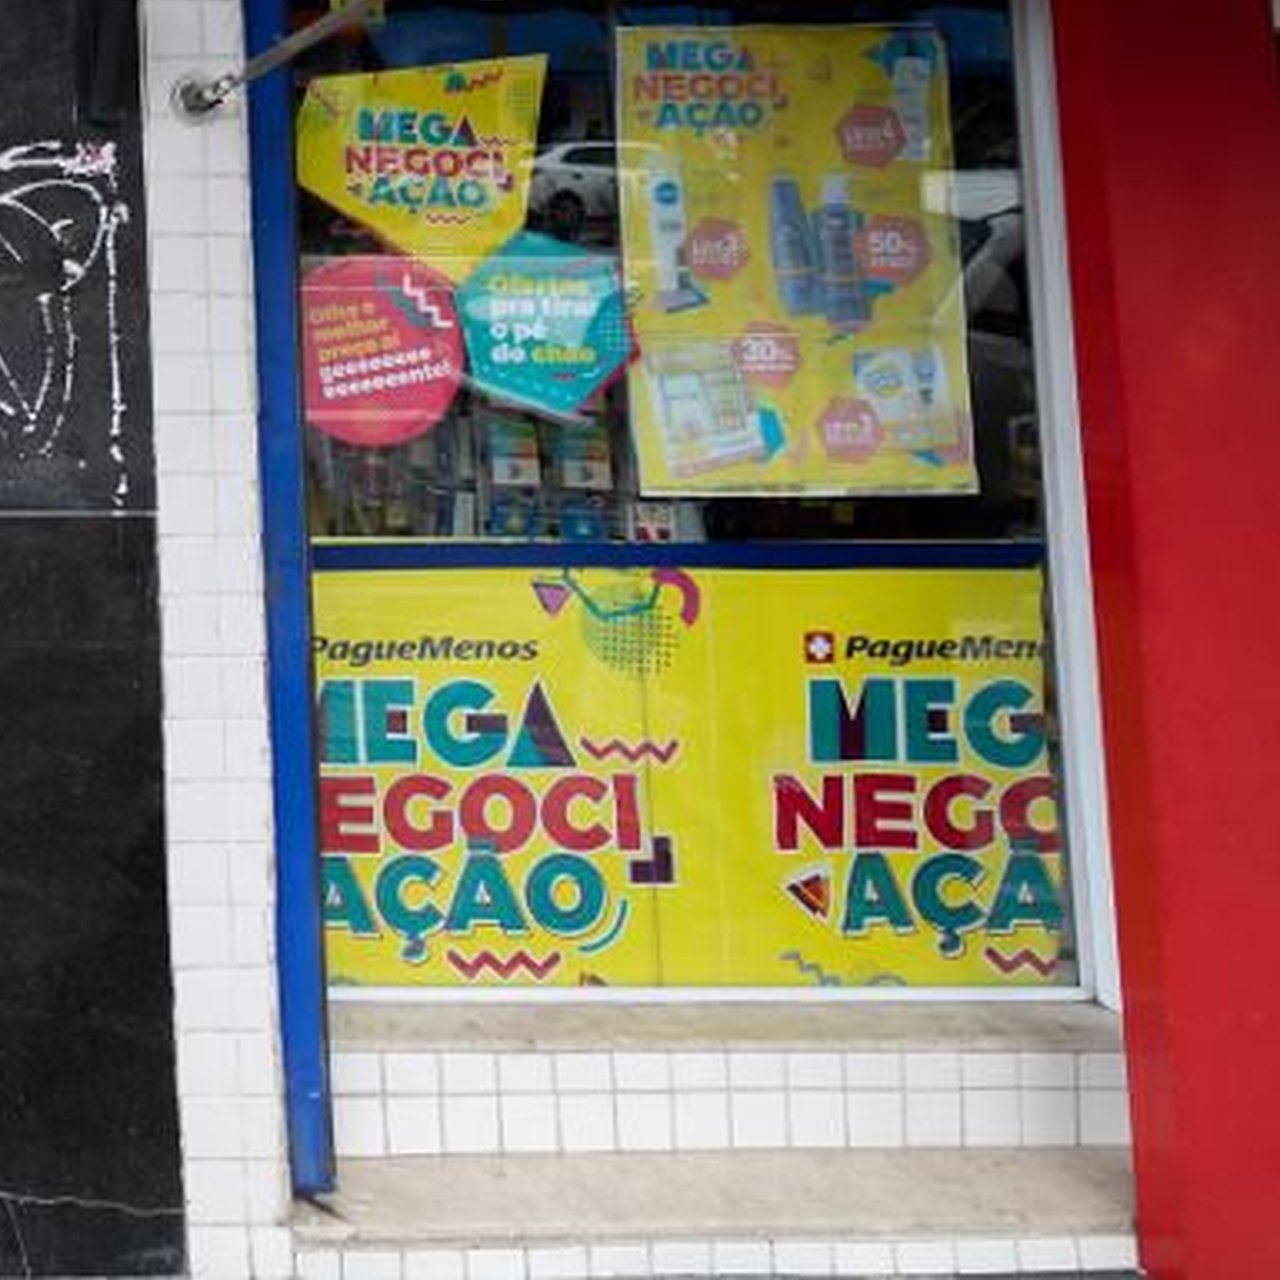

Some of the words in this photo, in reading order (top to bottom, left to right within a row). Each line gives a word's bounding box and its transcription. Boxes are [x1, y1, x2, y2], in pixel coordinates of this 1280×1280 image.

[646, 40, 754, 72] MEGA
[357, 106, 478, 147] MEGA
[346, 146, 504, 176] NEGOCI
[369, 174, 486, 213] AÇÃO
